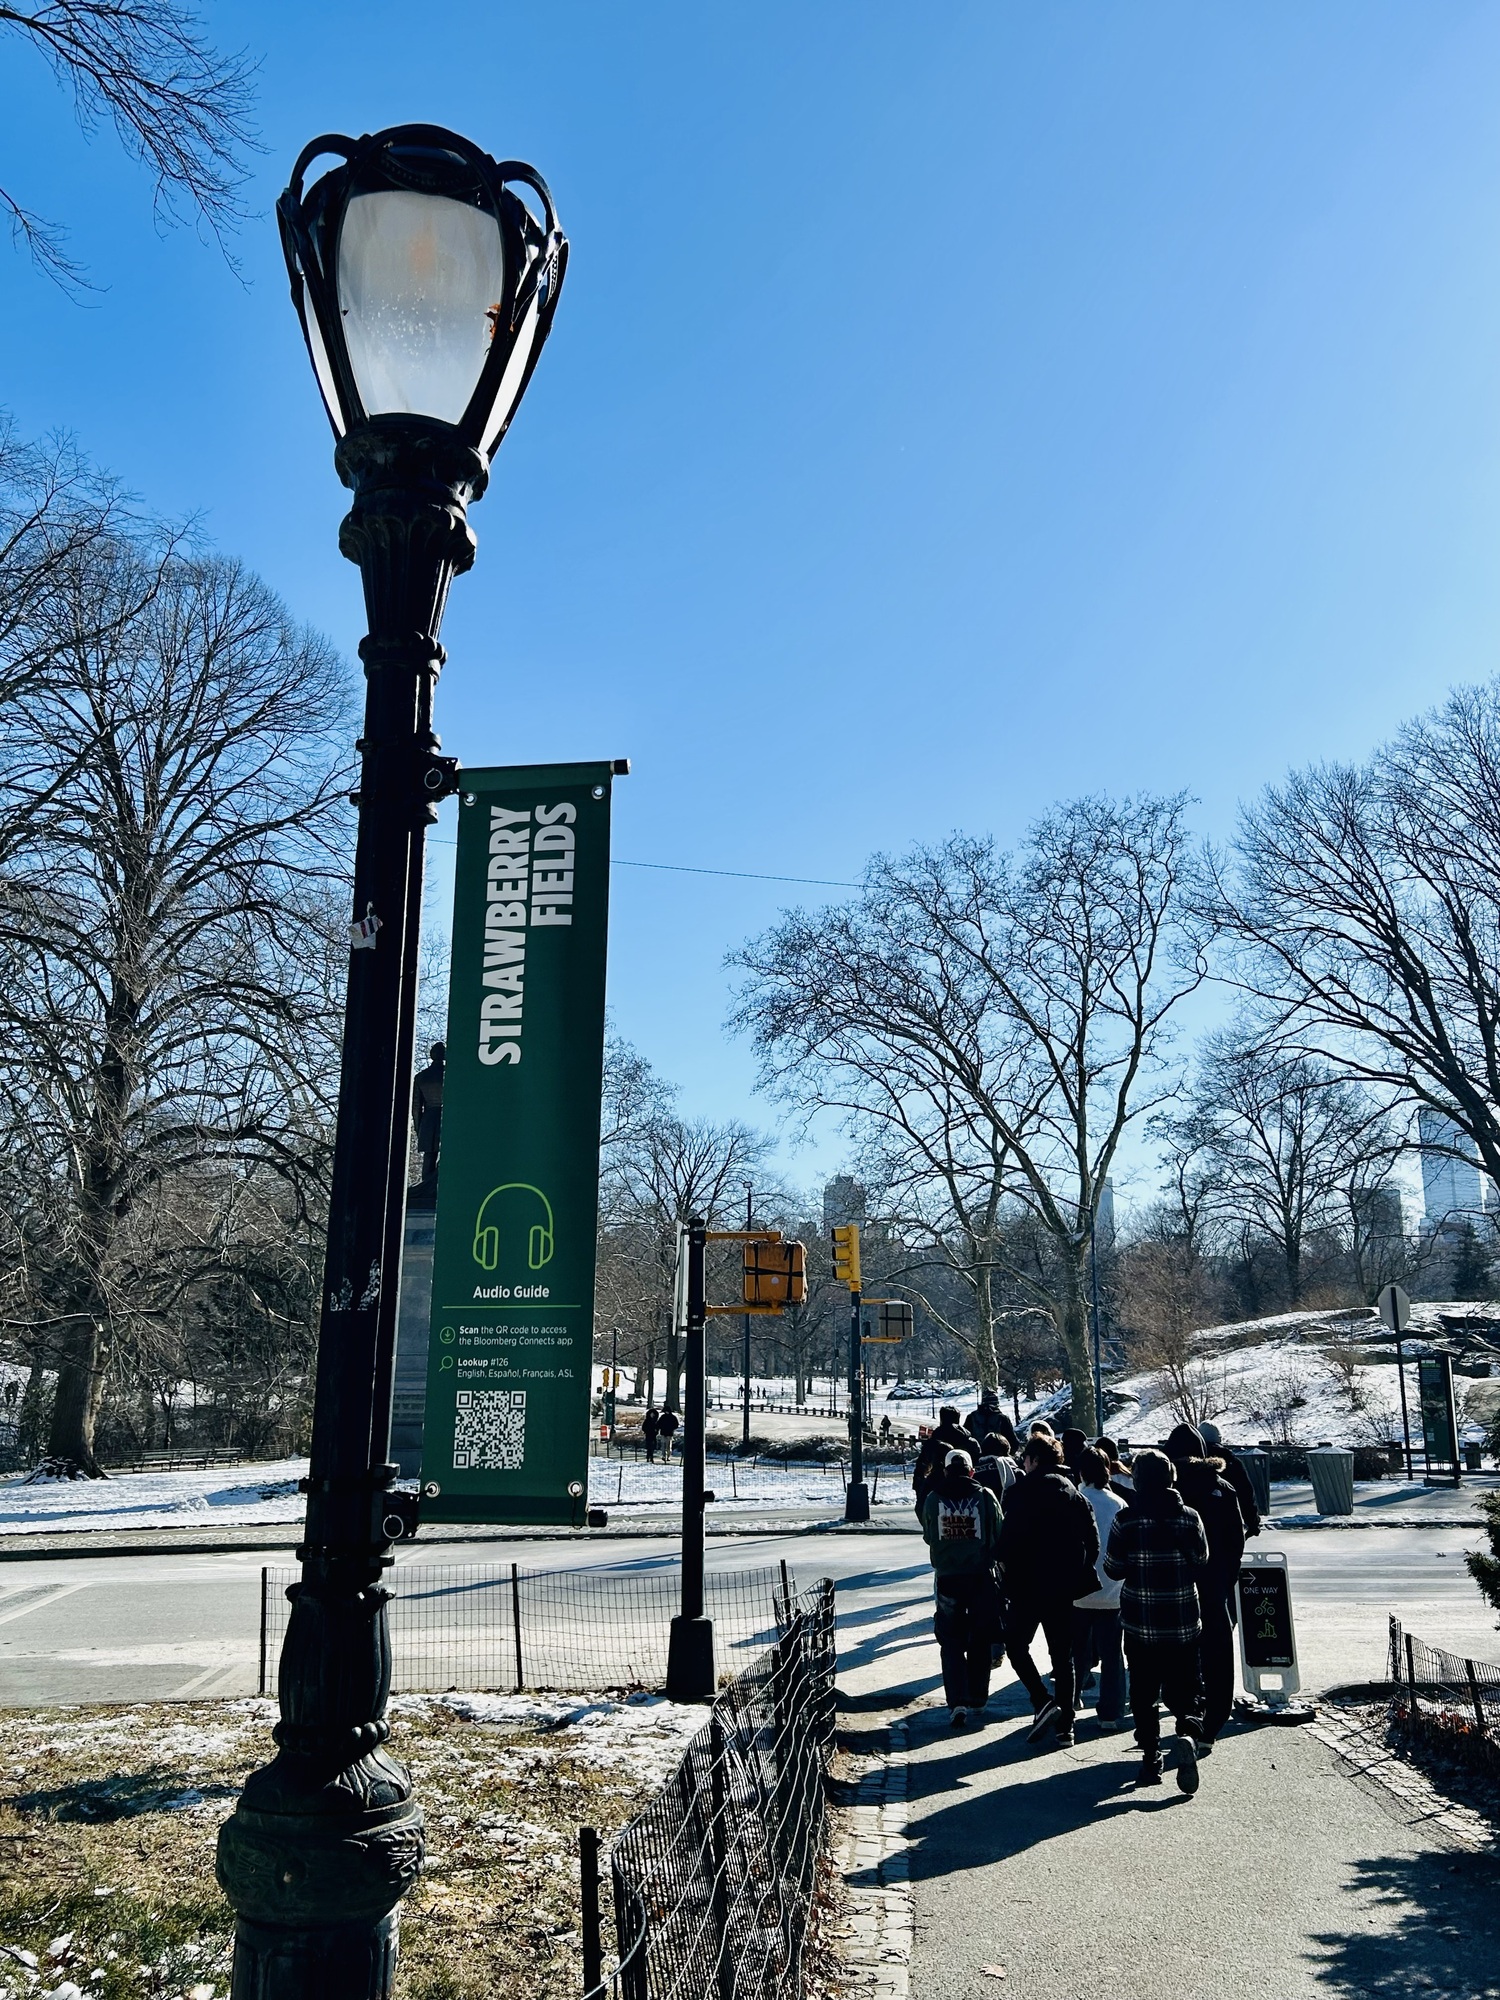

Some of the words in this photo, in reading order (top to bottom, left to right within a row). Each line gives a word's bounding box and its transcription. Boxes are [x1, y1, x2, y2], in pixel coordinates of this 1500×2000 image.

[530, 802, 577, 927] FIELDS
[477, 805, 531, 1066] STRAWBERRY
[473, 1285, 511, 1299] Audio
[513, 1285, 550, 1298] Guide
[459, 1325, 479, 1335] Scan
[480, 1325, 494, 1335] the
[495, 1325, 509, 1335] QR
[510, 1325, 529, 1334] code
[531, 1326, 539, 1334] to
[541, 1326, 567, 1334] access
[458, 1337, 472, 1345] the
[473, 1336, 517, 1347] Bloomberg
[518, 1336, 555, 1345] Connects
[557, 1337, 573, 1347] app
[457, 1358, 489, 1368] Lookup
[490, 1357, 509, 1367] #126
[457, 1369, 487, 1379] English,
[488, 1368, 522, 1379] Español,
[522, 1368, 556, 1379] Français,
[557, 1368, 574, 1378] ASL
[1243, 1586, 1259, 1594] ONE
[1261, 1586, 1279, 1594] WAY
